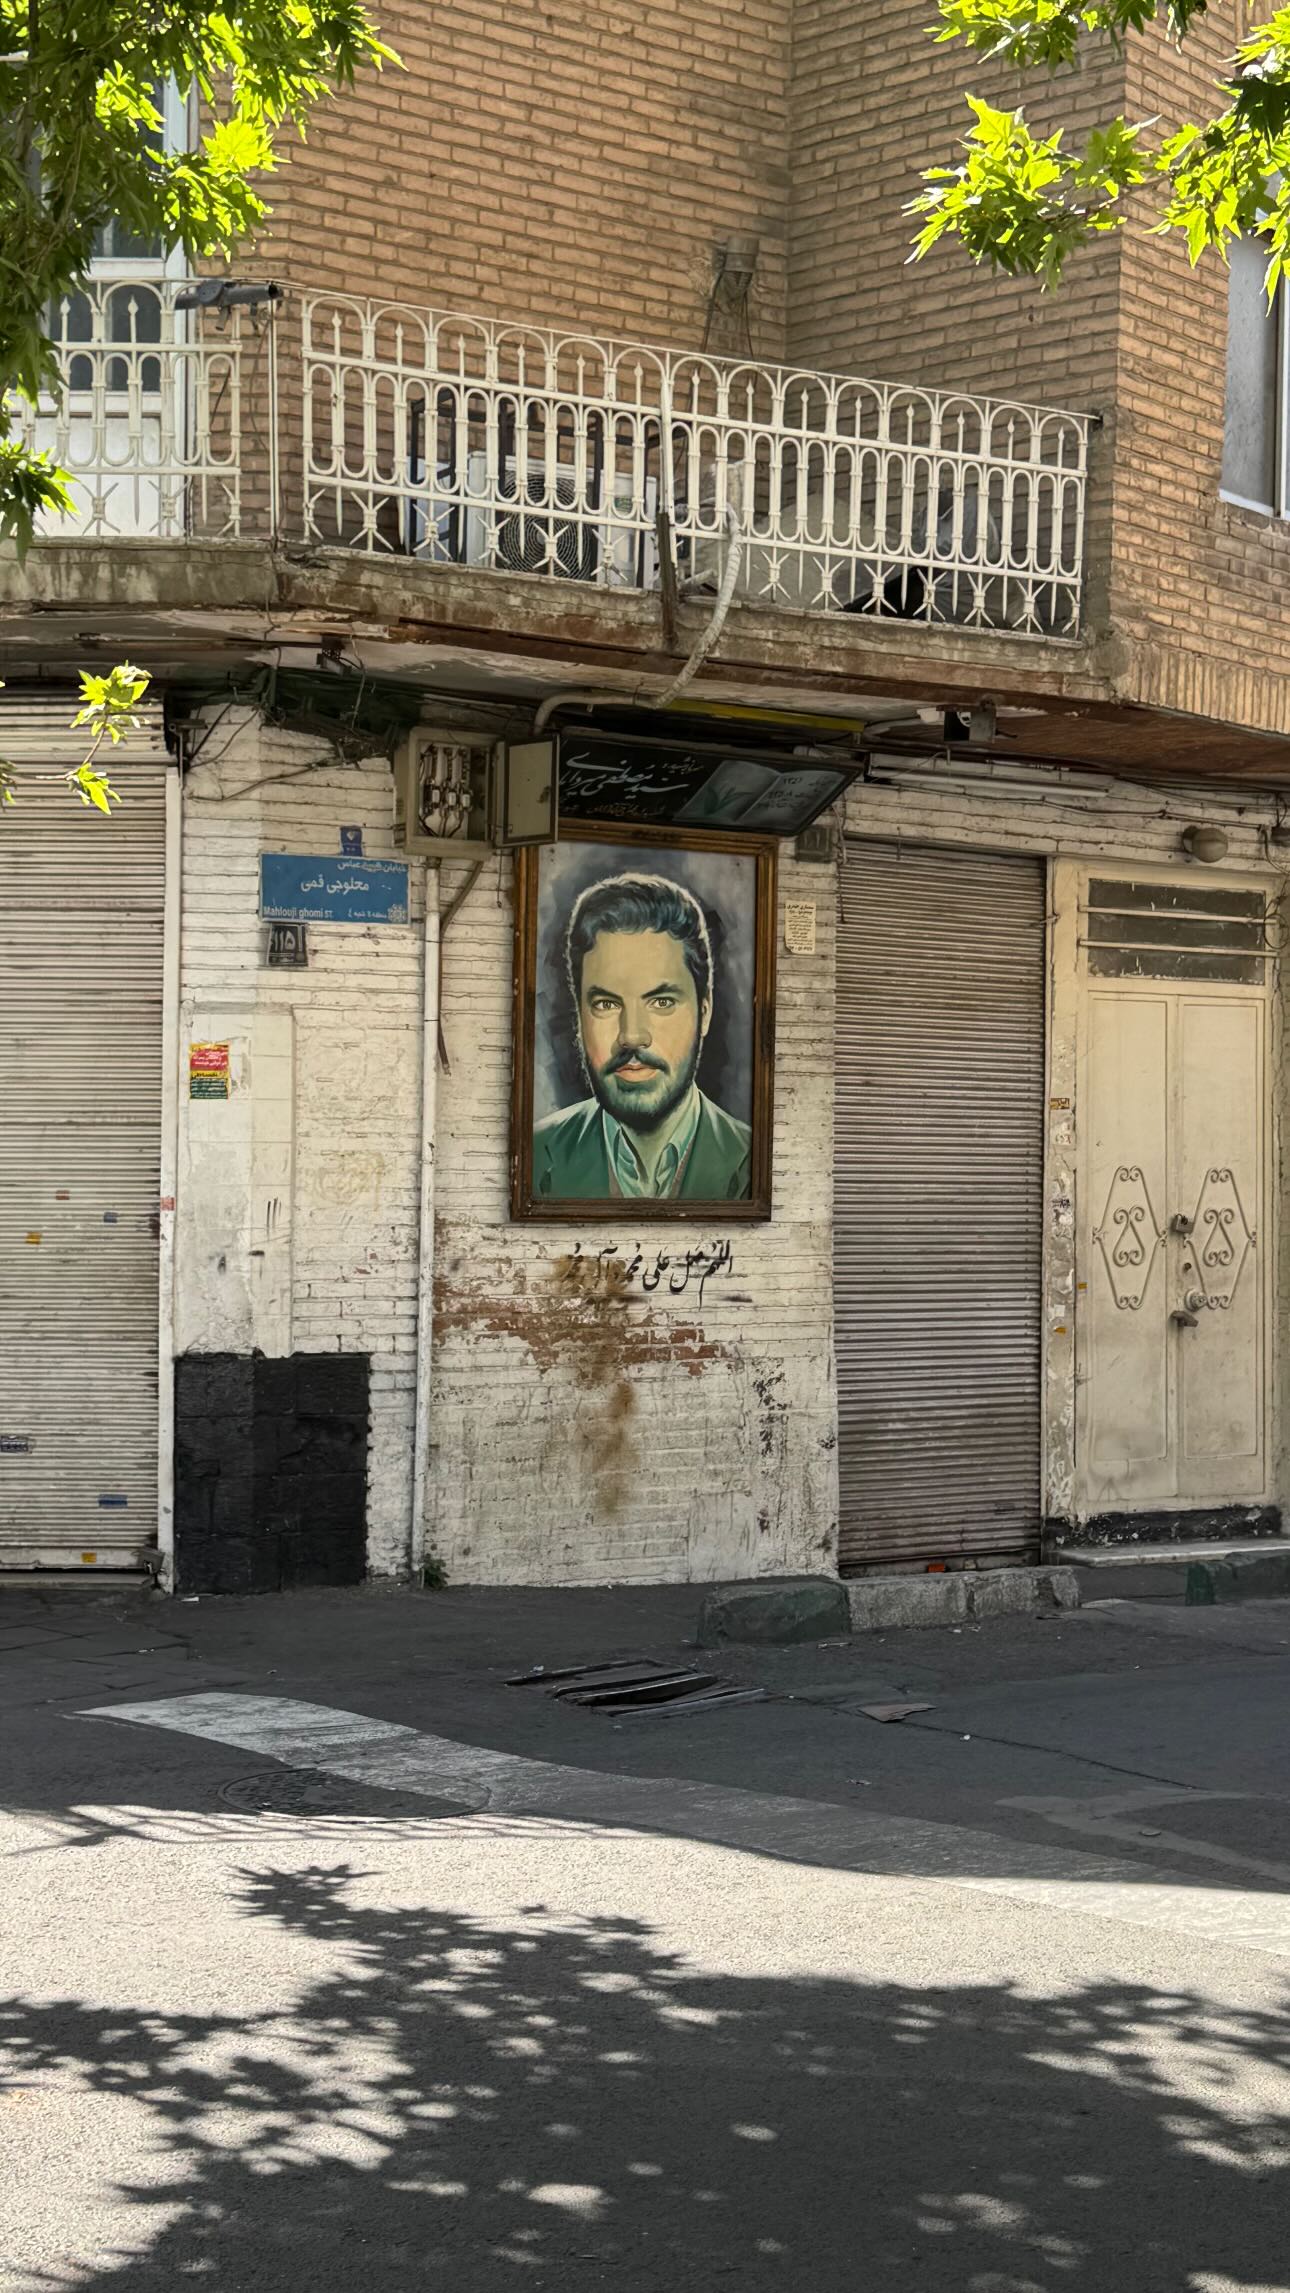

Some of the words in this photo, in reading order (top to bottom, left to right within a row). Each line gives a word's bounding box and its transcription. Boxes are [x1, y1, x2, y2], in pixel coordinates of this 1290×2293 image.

[337, 858, 361, 871] عباس
[383, 863, 407, 873] خیابان
[300, 873, 324, 892] قمی
[326, 877, 369, 895] محلوجی
[263, 905, 297, 920] Mahlouji
[298, 907, 324, 919] ghomi
